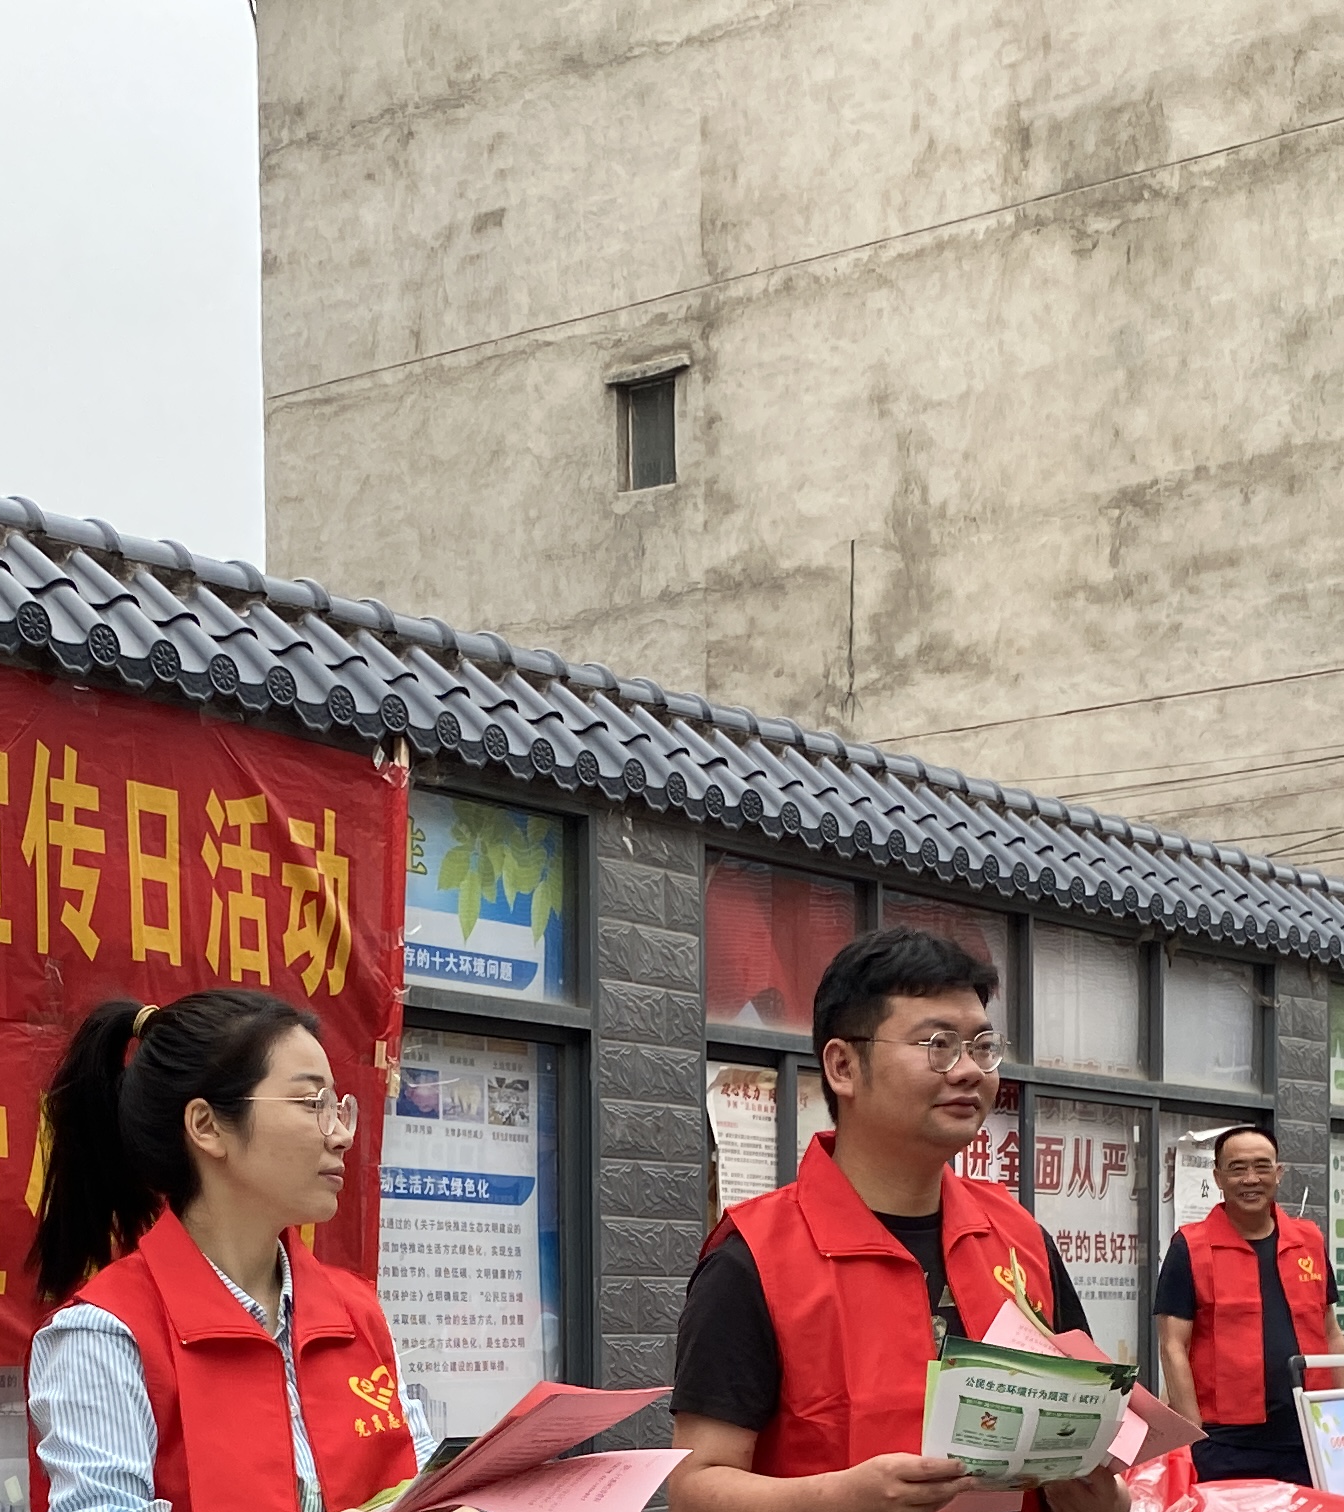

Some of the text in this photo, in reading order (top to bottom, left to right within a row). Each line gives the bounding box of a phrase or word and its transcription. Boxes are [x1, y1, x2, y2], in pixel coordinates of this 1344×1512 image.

[404, 945, 513, 982] 存的十大环境问题
[381, 1173, 490, 1199] 动生活方式绿色化
[378, 1242, 522, 1258] 须加快推动生活方式绿色化，实现生活
